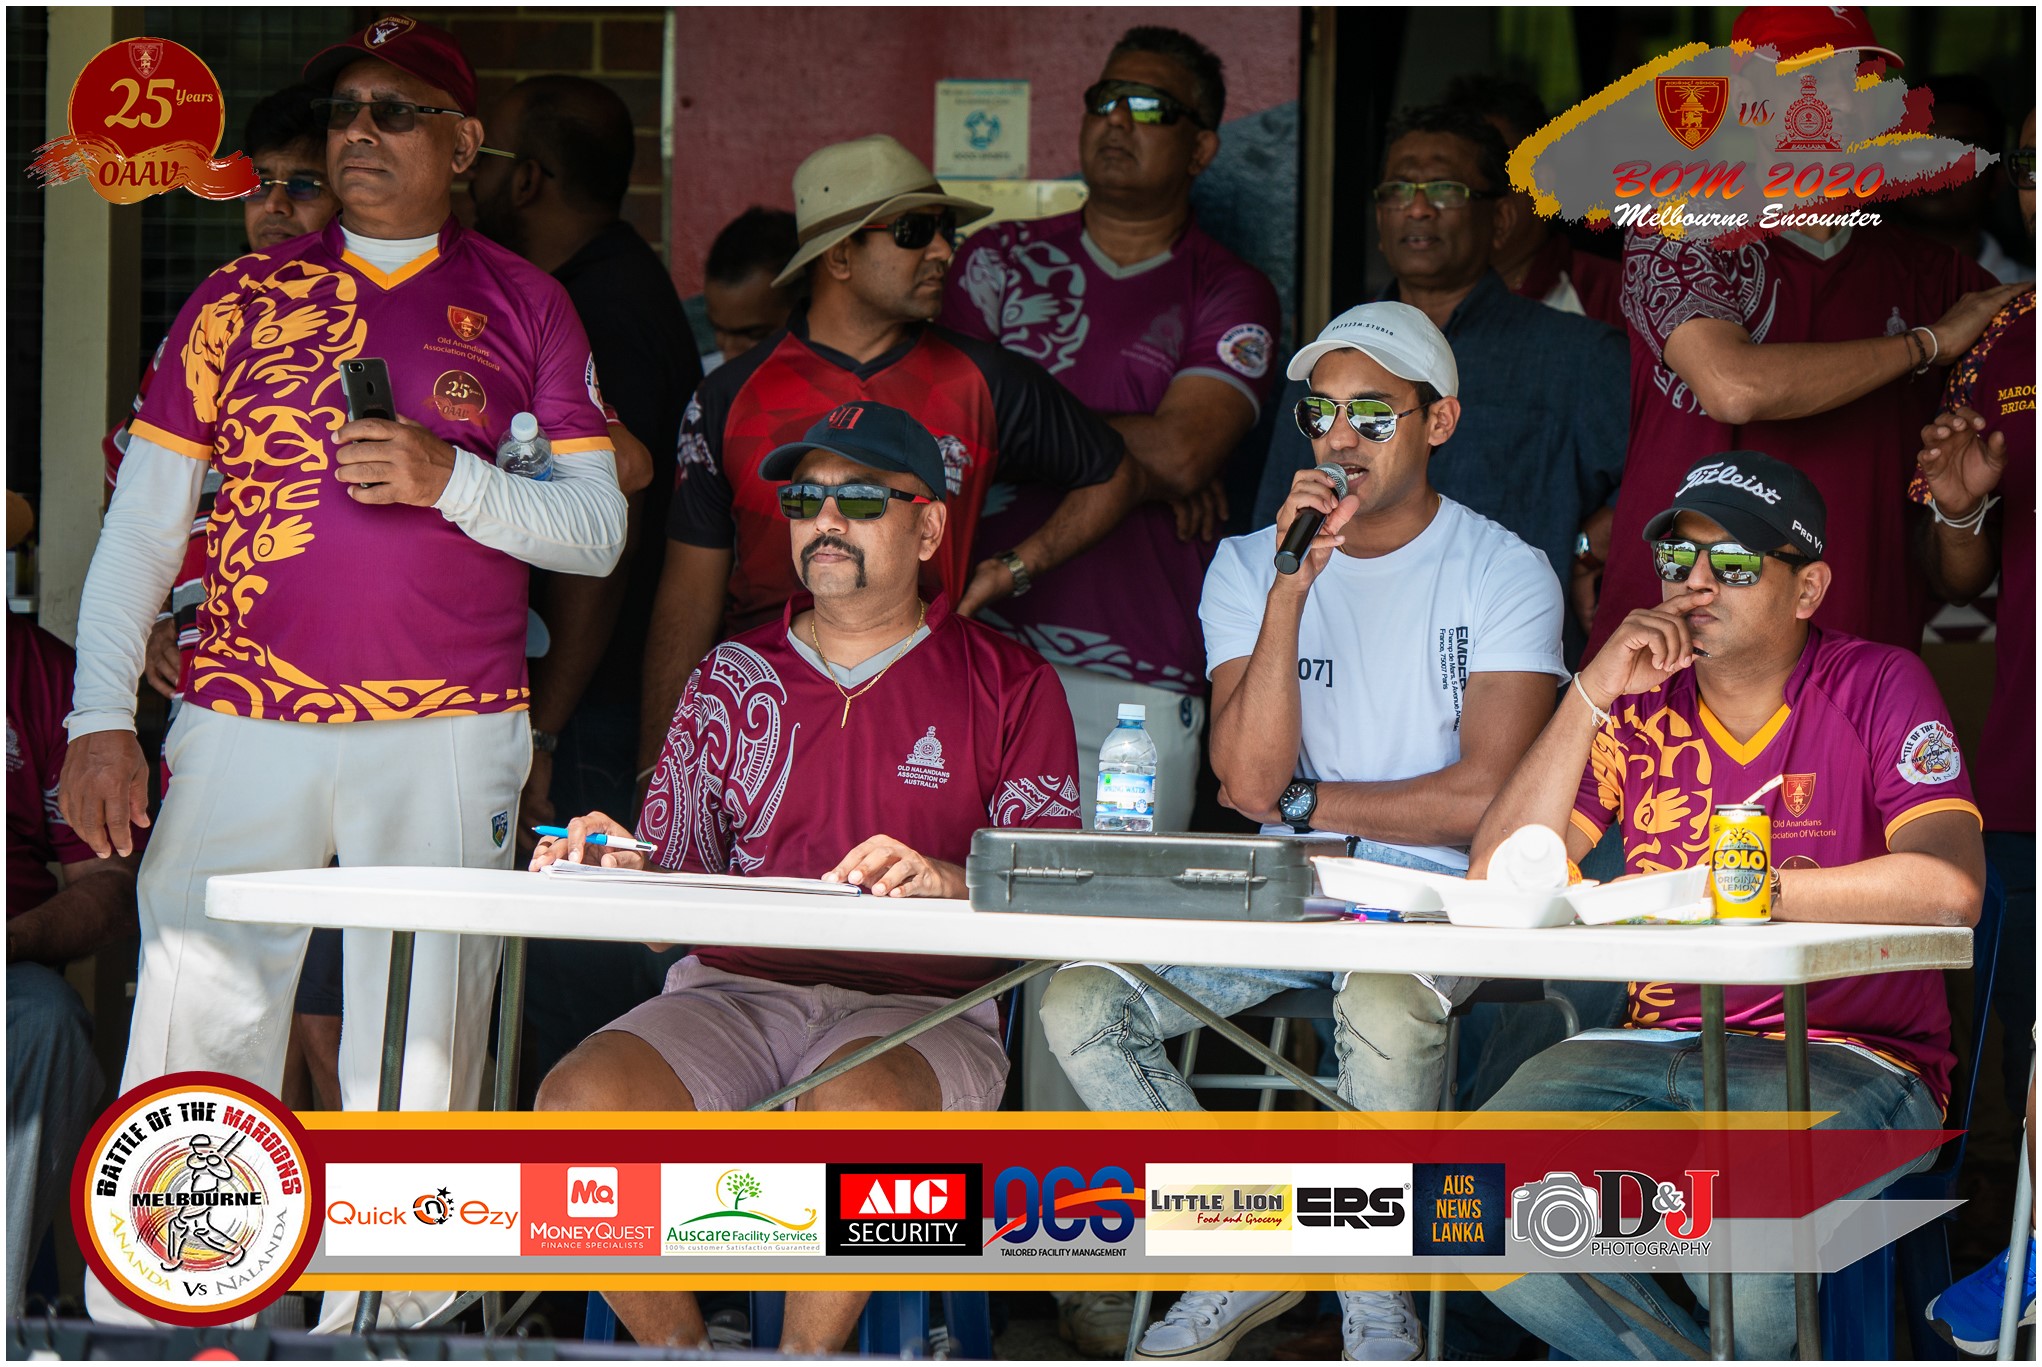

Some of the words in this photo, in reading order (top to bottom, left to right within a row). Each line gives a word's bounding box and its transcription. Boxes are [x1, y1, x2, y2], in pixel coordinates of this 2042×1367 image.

[437, 336, 452, 345] Old
[452, 339, 490, 357] Anandians
[423, 343, 466, 358] Association
[466, 352, 476, 361] Of
[476, 356, 500, 372] Victoria
[445, 380, 470, 399] 25
[1675, 461, 1782, 505] Titleist
[1447, 628, 1455, 653] Champ
[897, 764, 911, 772] OLD
[911, 766, 950, 778] NALANDIANS
[897, 771, 938, 782] ASSOCIATION
[904, 778, 939, 789] AUSTRALIA
[1772, 819, 1785, 828] Old
[1786, 818, 1822, 828] Anandians
[1799, 829, 1808, 838] Of
[1808, 829, 1837, 838] Victoria
[1714, 849, 1766, 870] SOLO
[1717, 875, 1761, 885] ORIGINAL
[1722, 884, 1757, 893] LEMON
